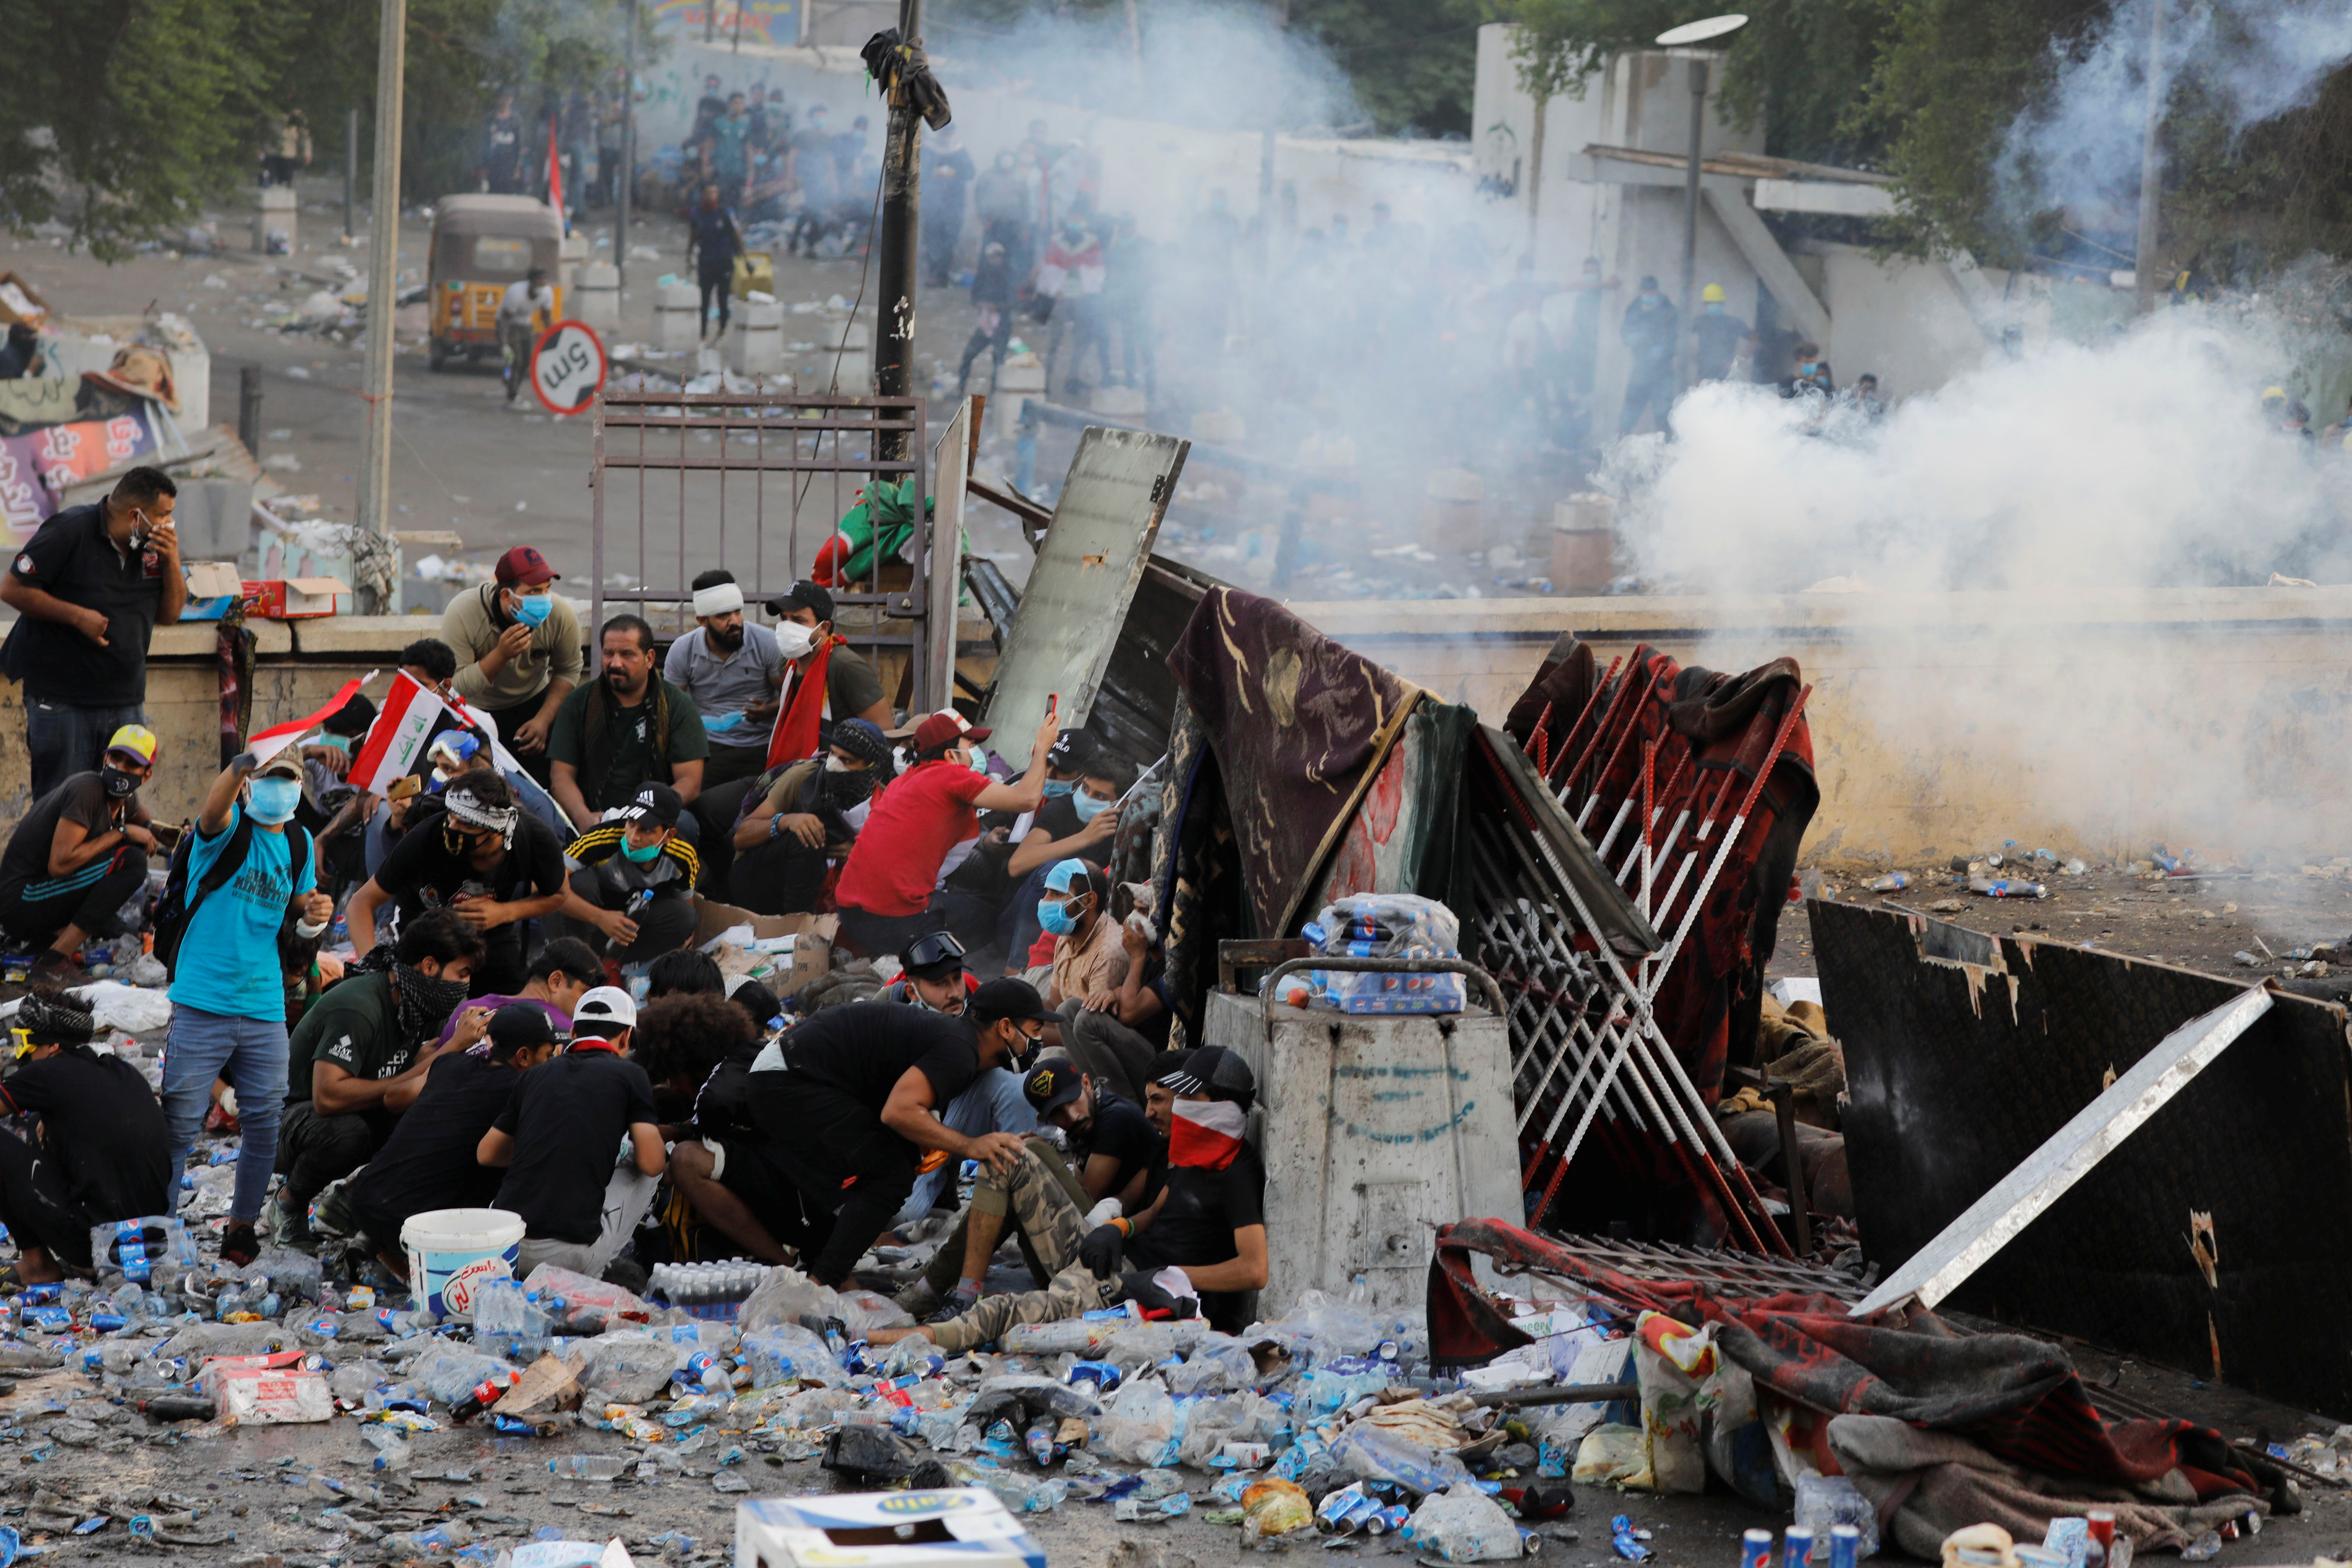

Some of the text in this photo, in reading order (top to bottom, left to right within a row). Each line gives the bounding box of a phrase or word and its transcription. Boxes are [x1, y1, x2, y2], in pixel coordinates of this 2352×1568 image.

[543, 342, 590, 391] 5m
[1052, 741, 1070, 753] POLO
[1522, 1322, 1546, 1333] meer
